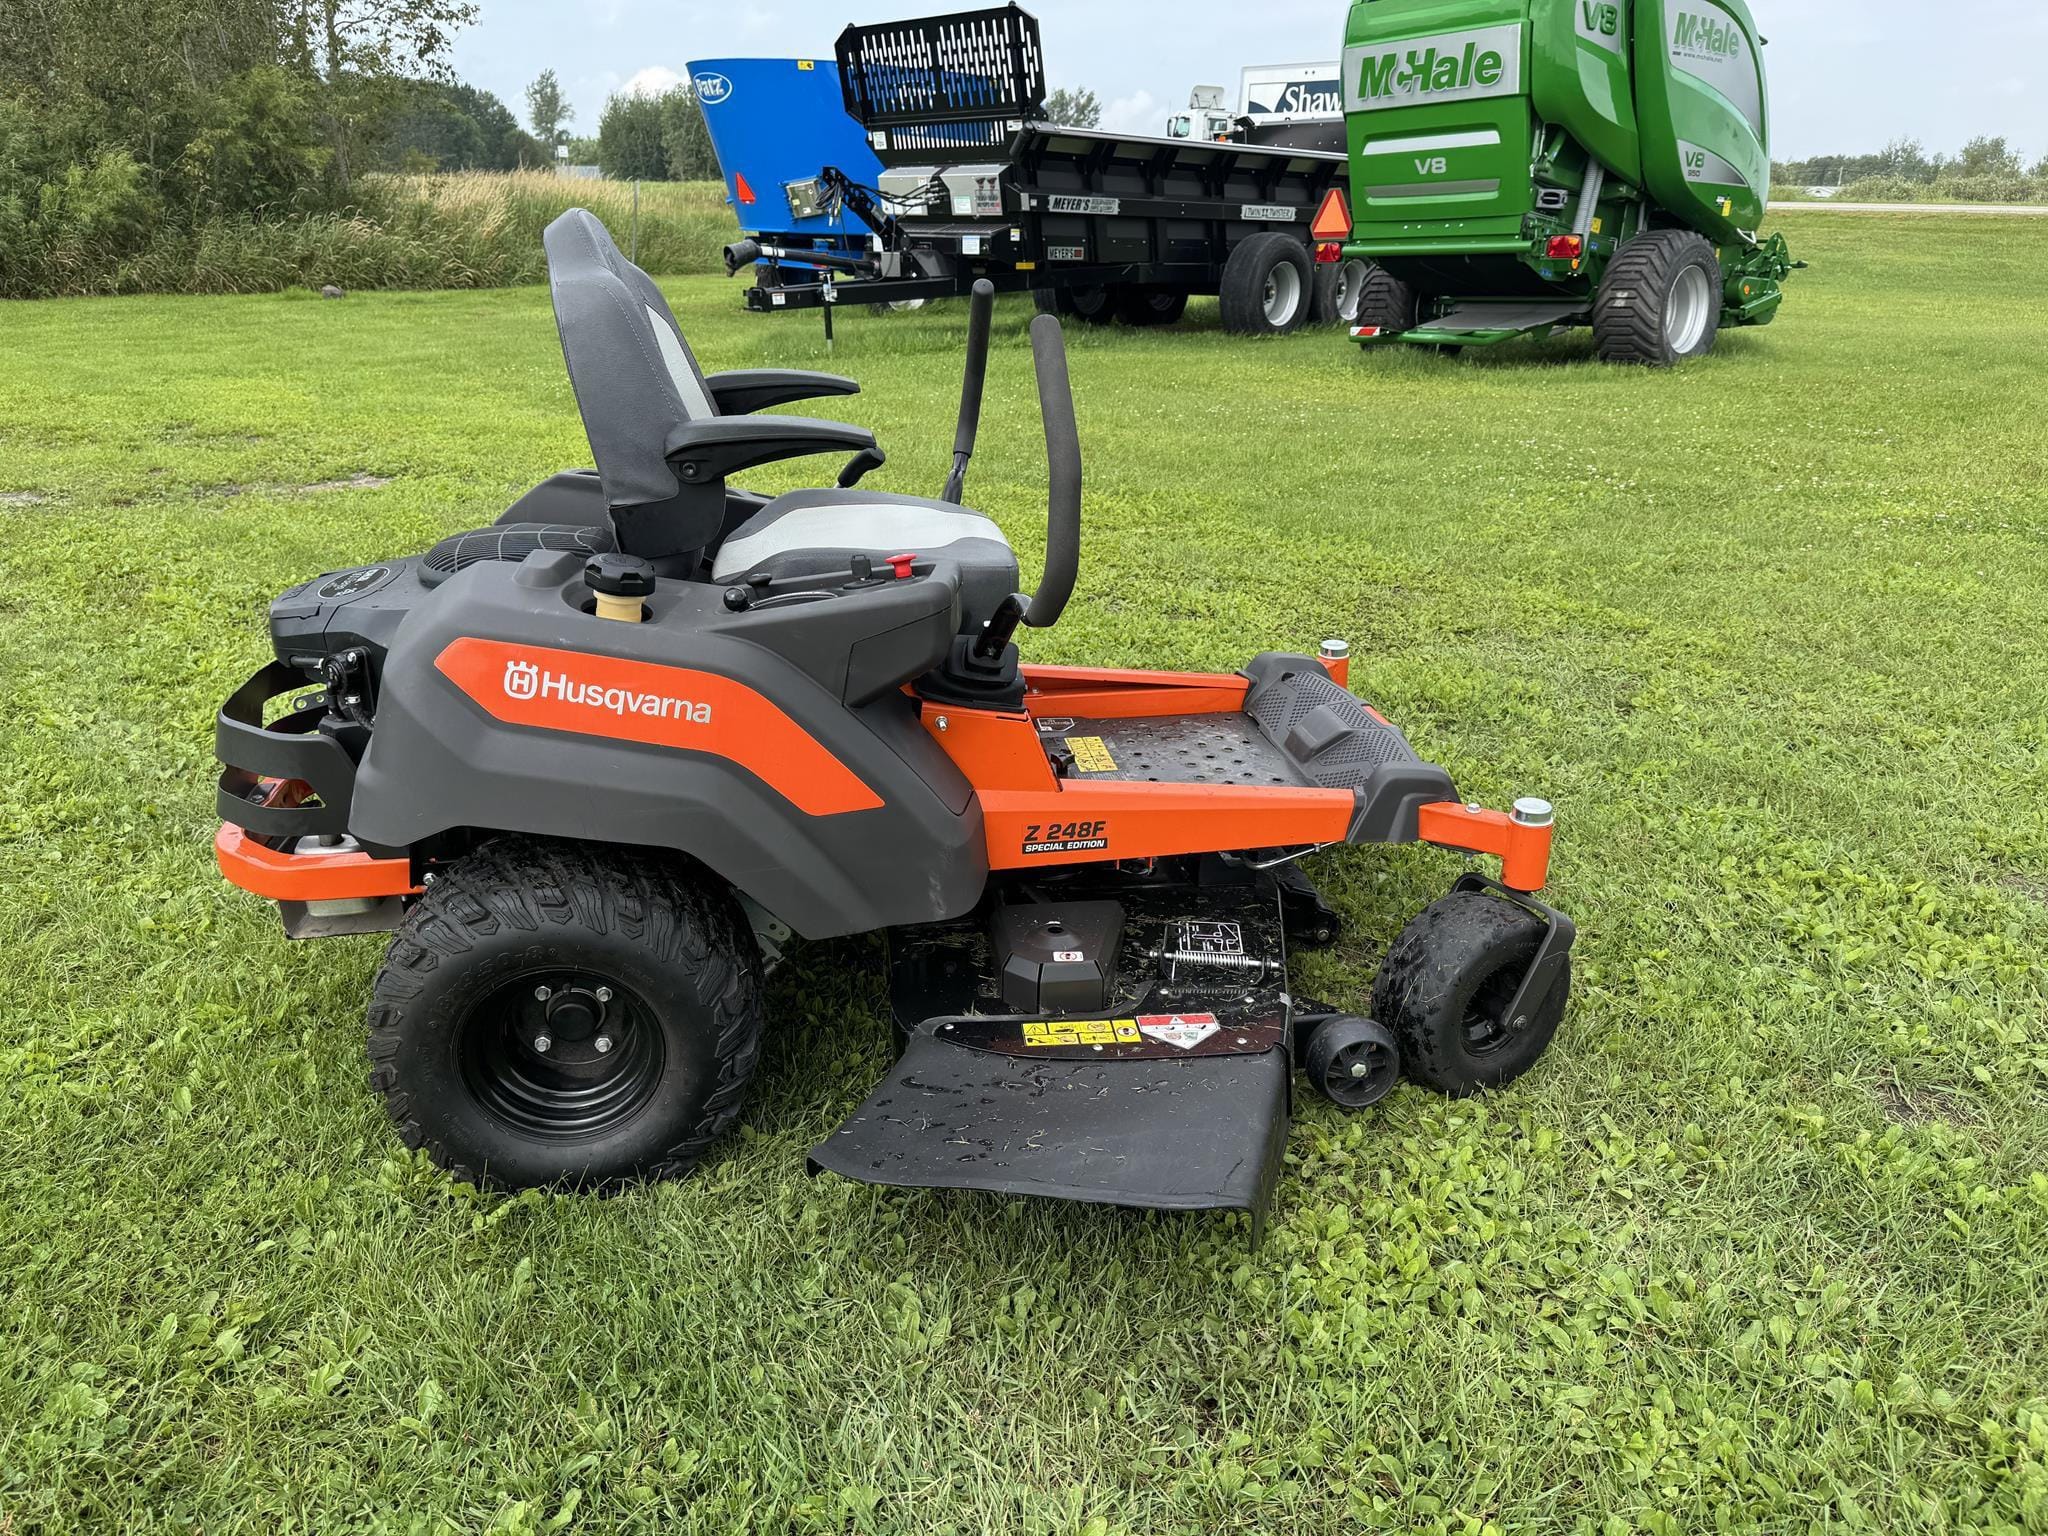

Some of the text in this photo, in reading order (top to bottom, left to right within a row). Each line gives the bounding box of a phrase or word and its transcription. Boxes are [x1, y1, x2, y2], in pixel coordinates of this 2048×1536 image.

[1582, 0, 1617, 36] V8
[1673, 12, 1739, 59] McHale
[1357, 42, 1503, 99] McHale
[1414, 157, 1447, 175] V8
[1684, 150, 1705, 168] V8
[1051, 197, 1091, 212] MEYER'S
[541, 671, 713, 724] Husqvarna
[1023, 821, 1107, 842] Z 248F
[1025, 840, 1105, 853] SPECIAL EDITION
